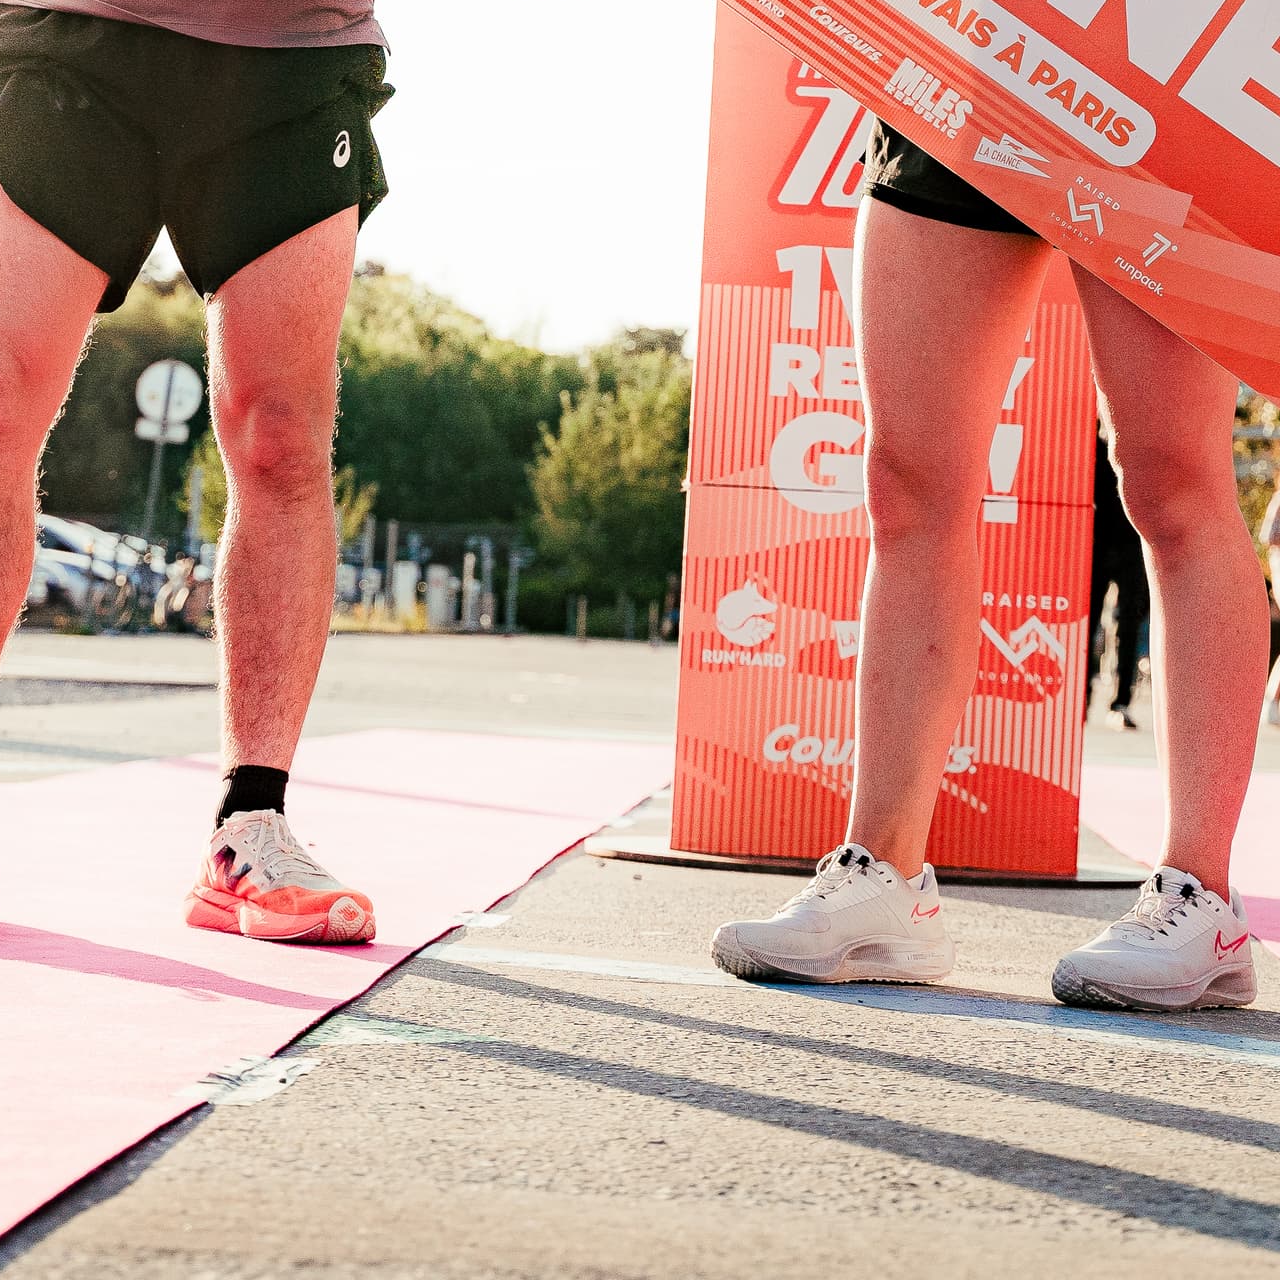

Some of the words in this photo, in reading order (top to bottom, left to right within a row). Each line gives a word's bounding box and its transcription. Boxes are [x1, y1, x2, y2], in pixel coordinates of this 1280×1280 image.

[993, 33, 1026, 74] À
[1027, 60, 1137, 148] PARIS
[883, 83, 959, 140] REPUBLIC
[977, 144, 991, 158] LA
[991, 150, 1022, 169] CHANCE
[1075, 175, 1121, 212] RAISED
[1050, 211, 1095, 246] together
[982, 591, 1070, 611] RAISED
[701, 648, 787, 668] RUN'HARD
